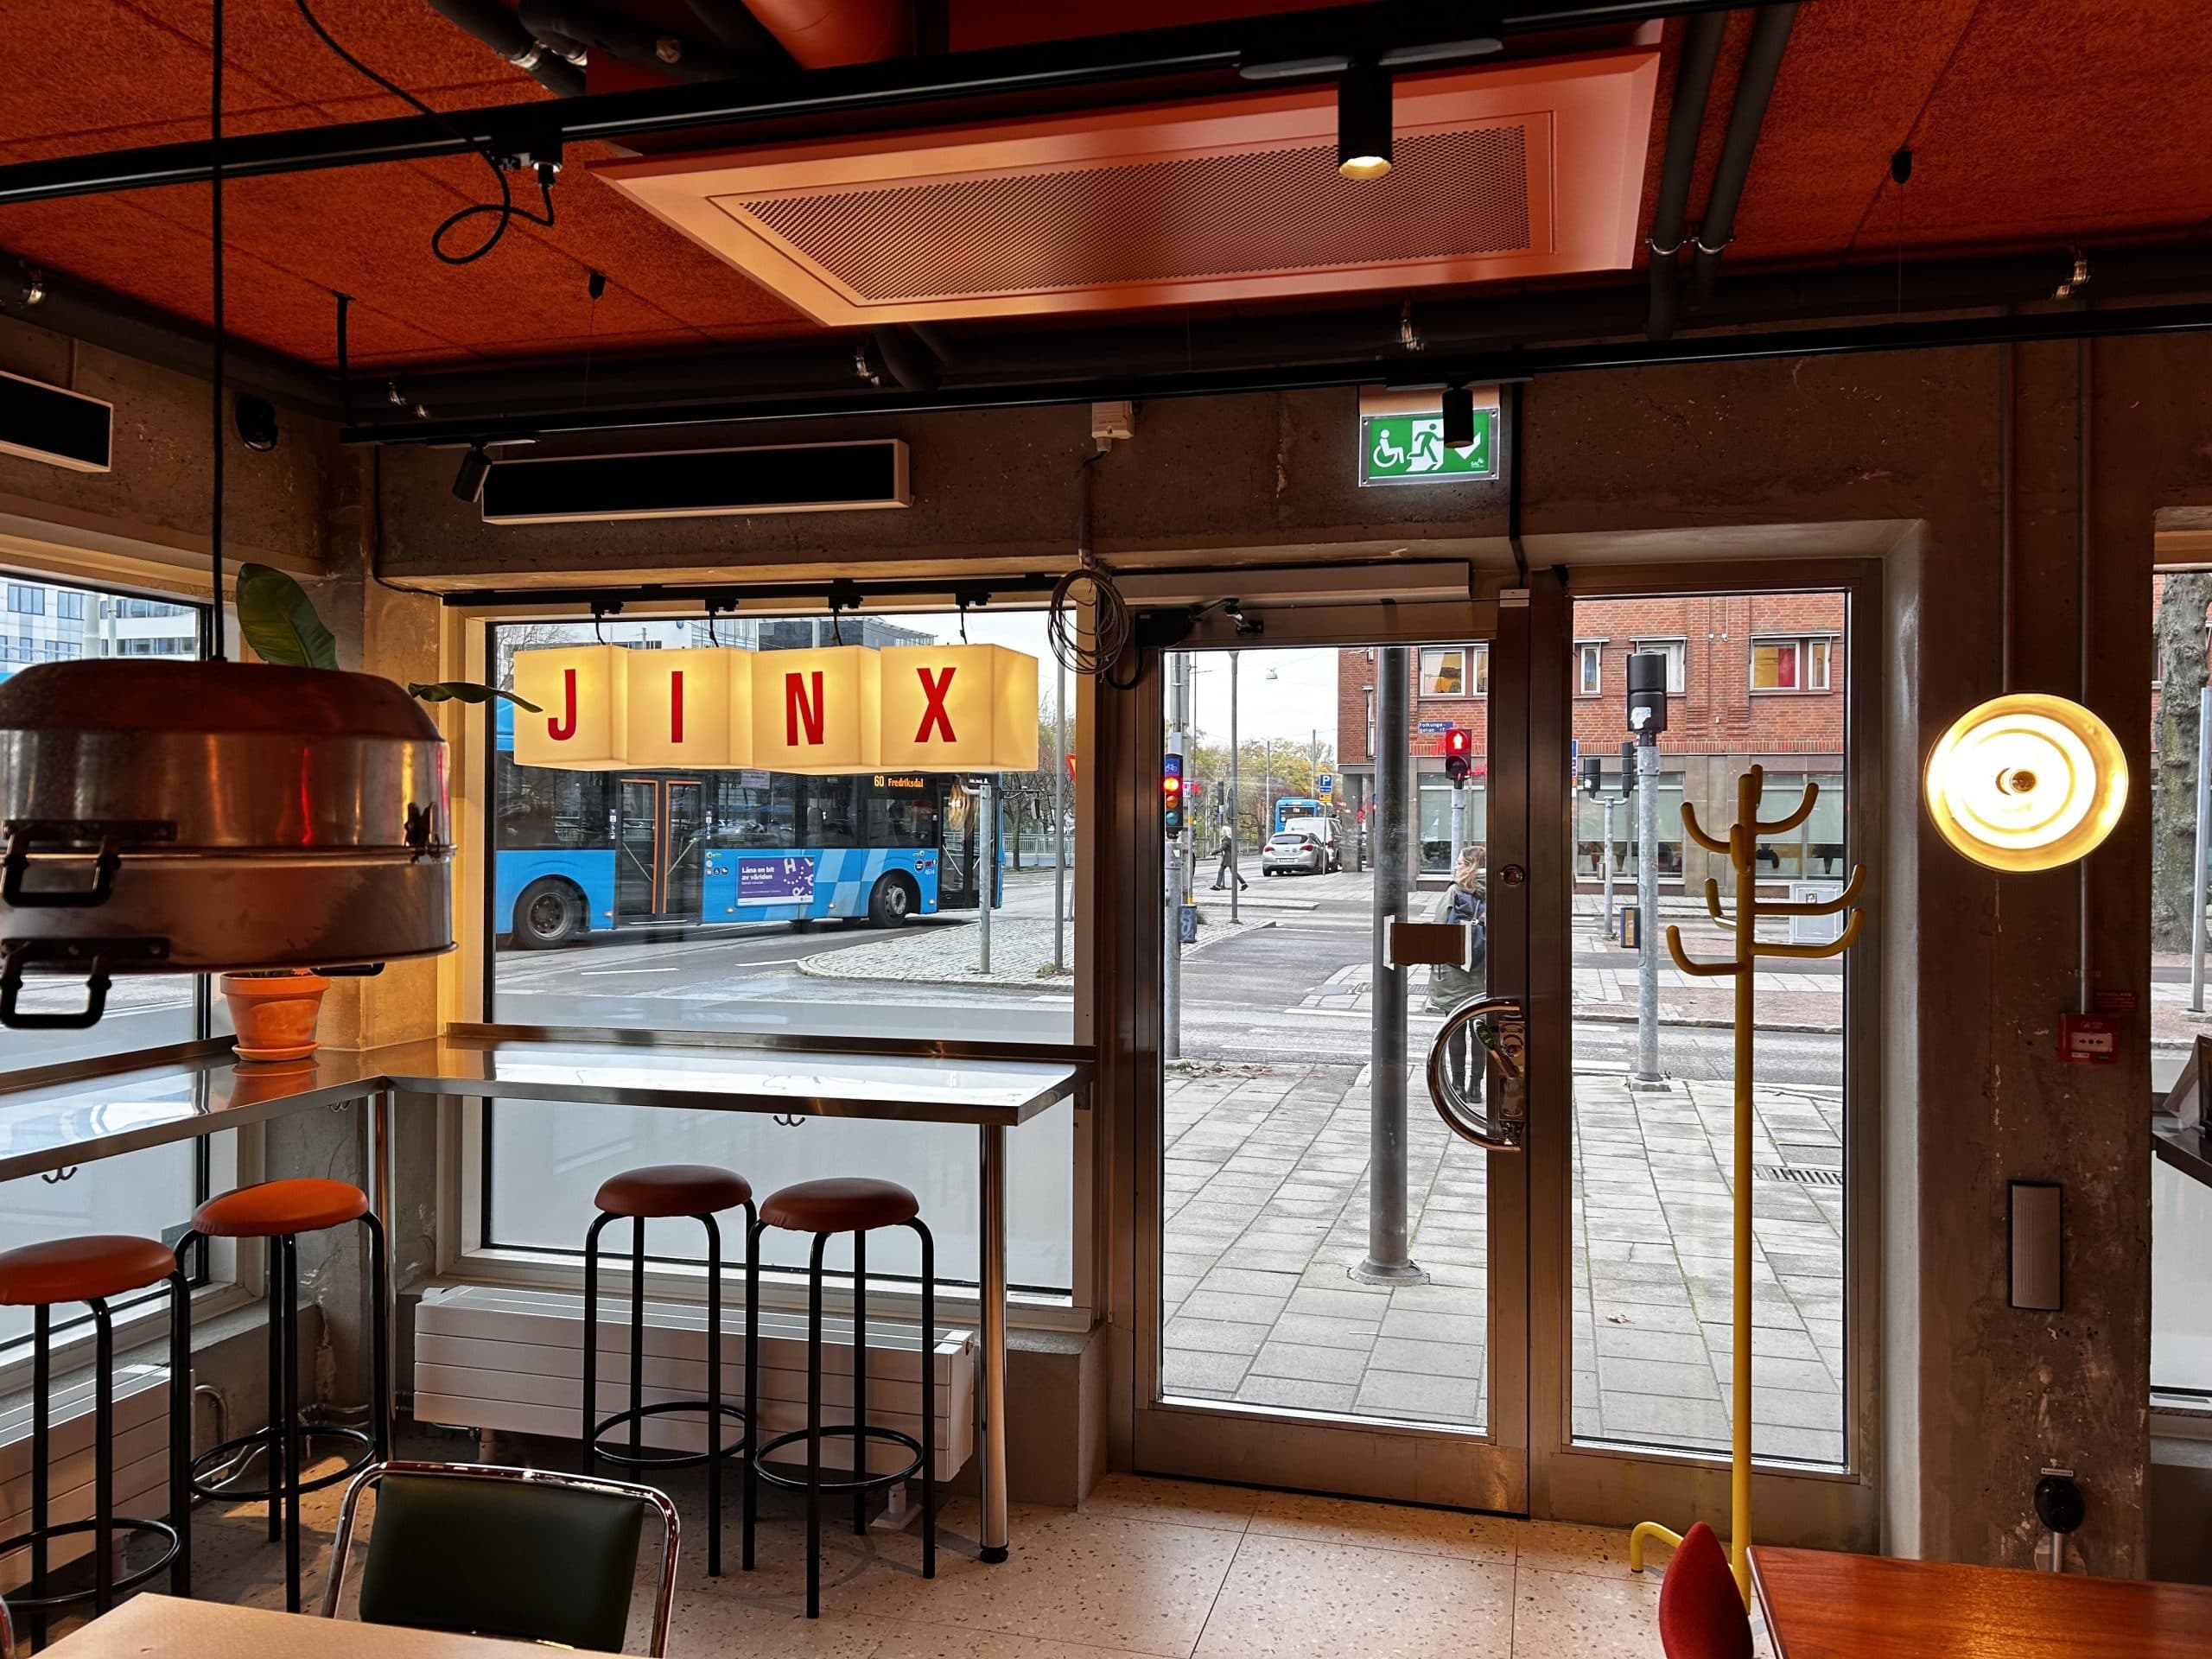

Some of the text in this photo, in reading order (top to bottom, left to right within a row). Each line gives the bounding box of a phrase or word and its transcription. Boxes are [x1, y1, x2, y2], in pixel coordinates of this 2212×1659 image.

[548, 667, 957, 747] JINX
[874, 775, 924, 788] 60 Fredriksdal
[1323, 775, 1331, 785] P
